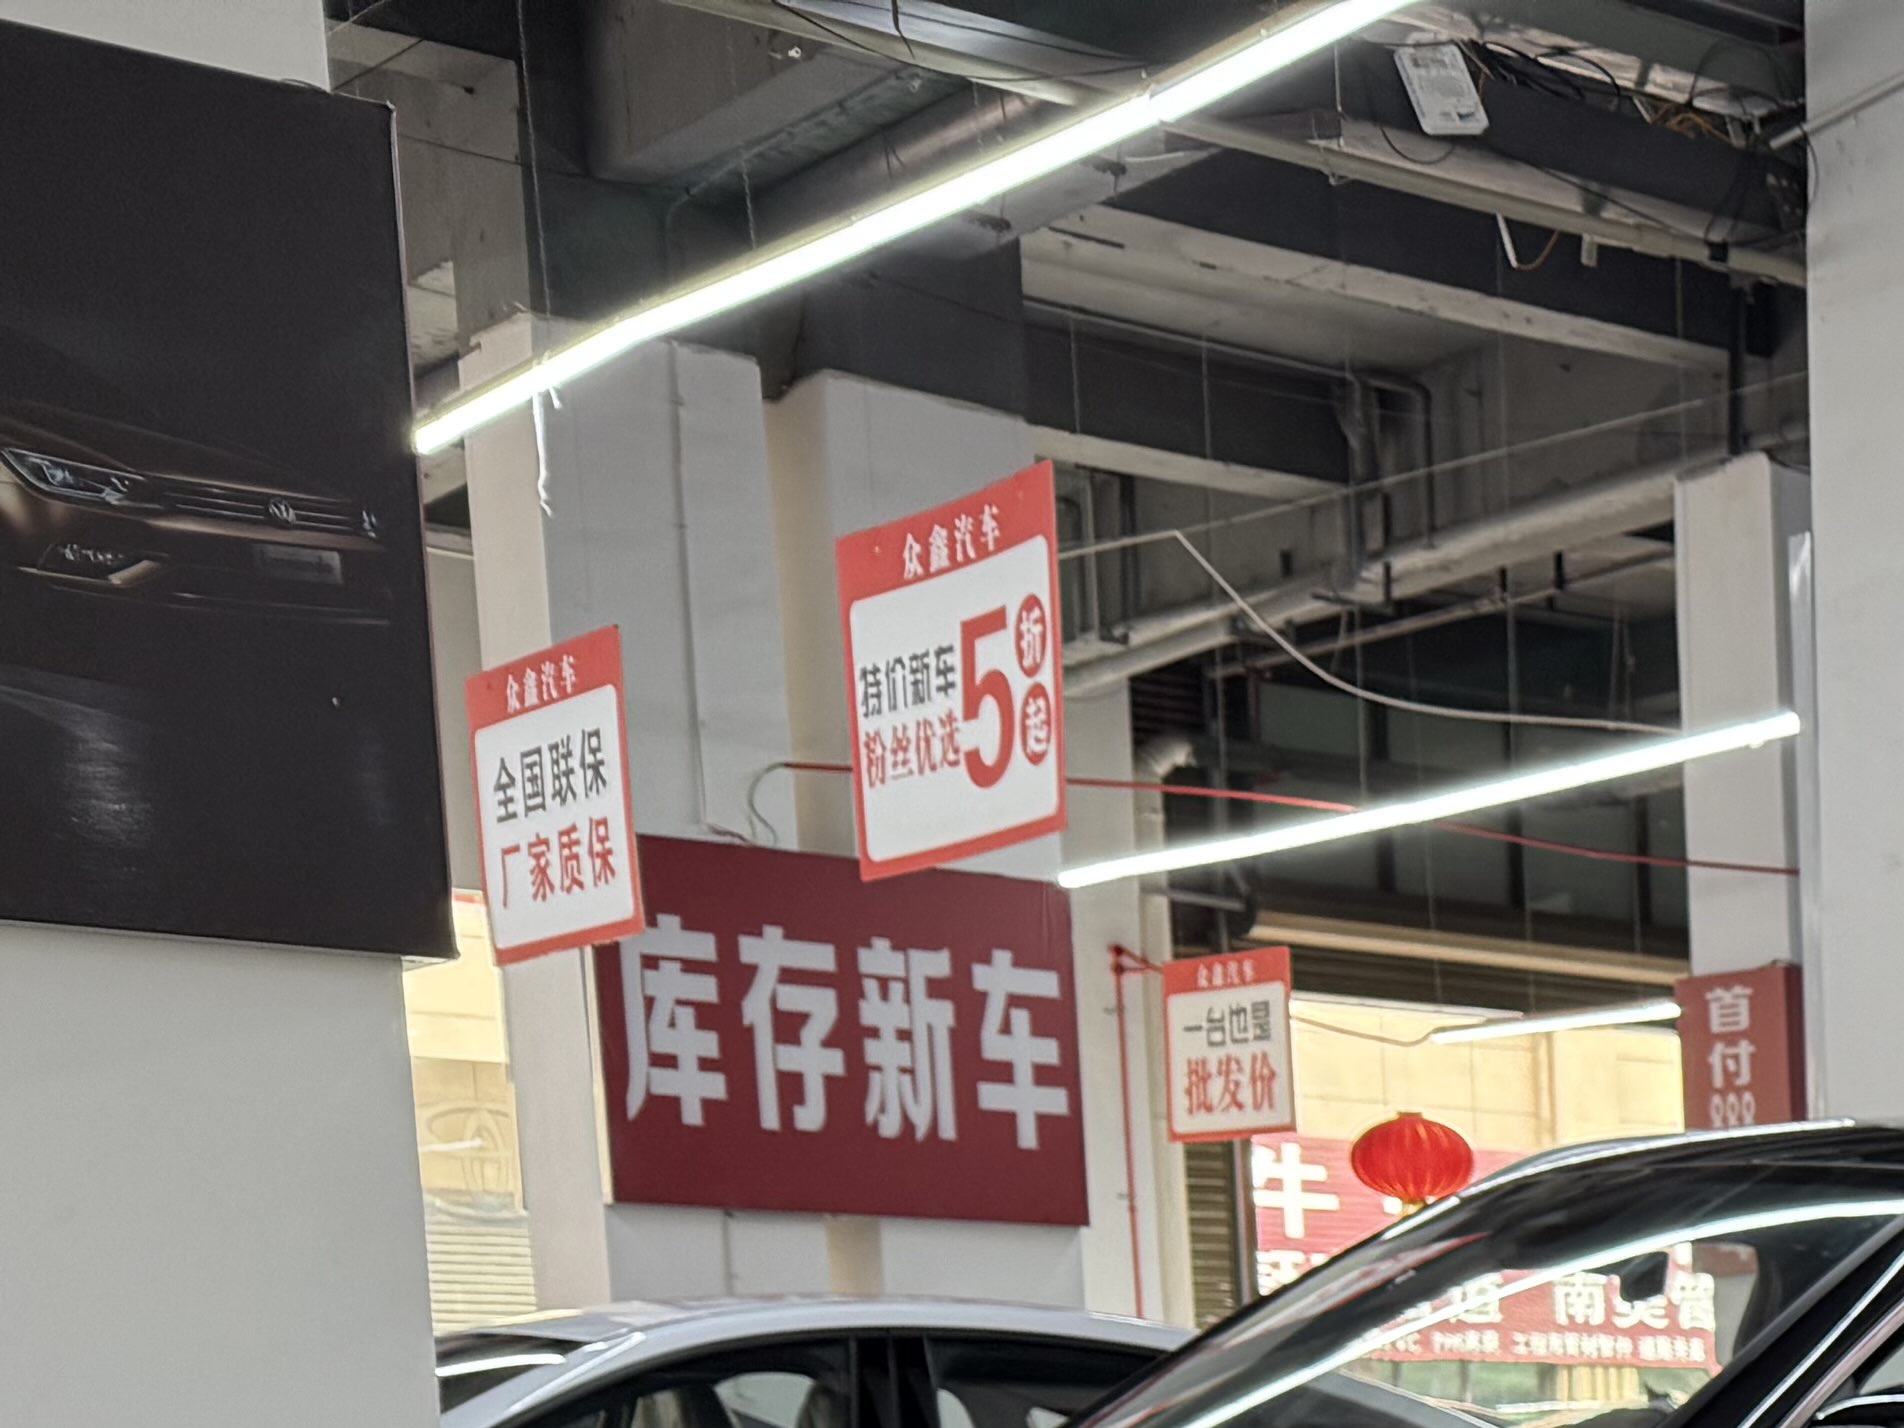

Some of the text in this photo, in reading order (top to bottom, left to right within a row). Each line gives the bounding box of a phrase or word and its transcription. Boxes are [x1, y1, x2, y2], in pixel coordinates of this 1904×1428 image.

[903, 505, 1000, 579] 众鑫汽车
[507, 654, 576, 713] 众鑫汽车
[860, 644, 956, 718] 特价新车
[960, 605, 1015, 788] 5
[494, 727, 608, 822] 全国联保
[864, 709, 961, 788] 粉丝优选
[501, 816, 616, 908] 厂家质保
[621, 913, 1071, 1153] 库存新车
[1182, 1000, 1271, 1047] 一台也是
[1185, 1051, 1276, 1116] 批发价
